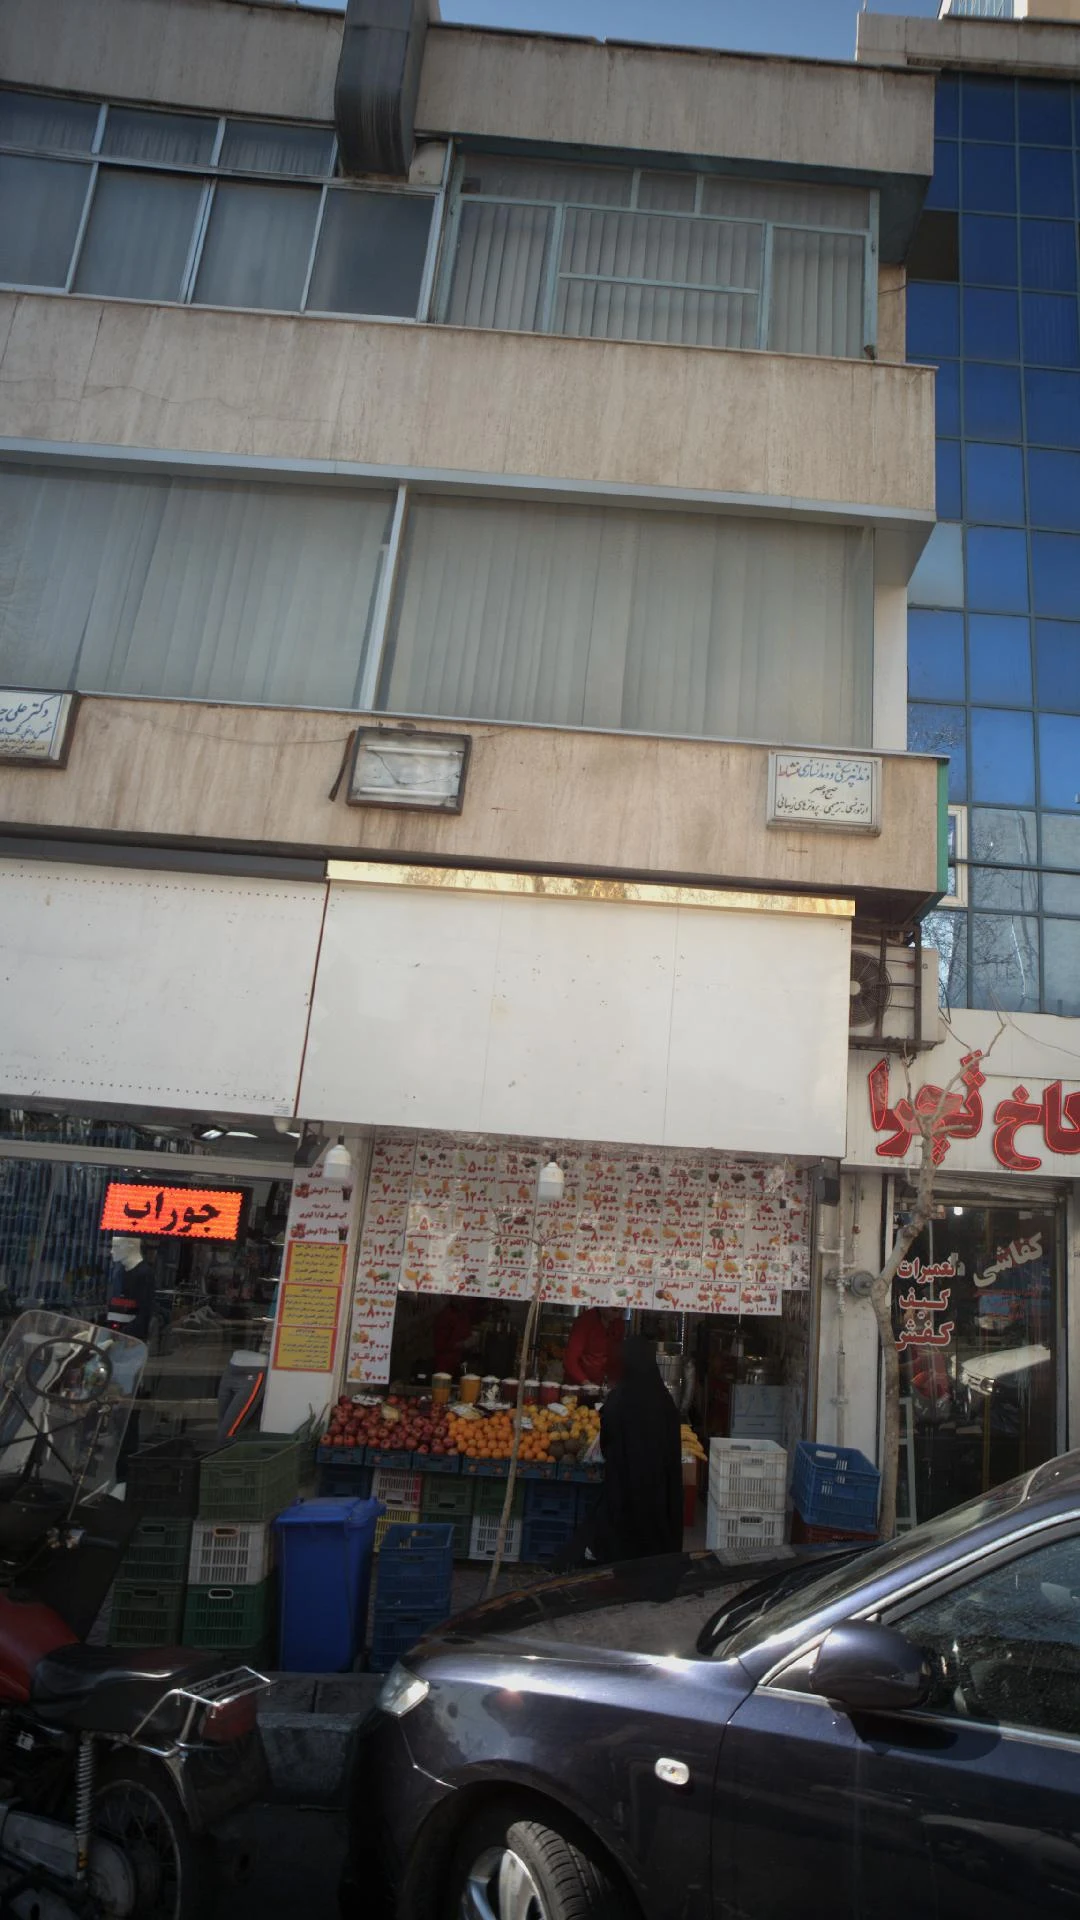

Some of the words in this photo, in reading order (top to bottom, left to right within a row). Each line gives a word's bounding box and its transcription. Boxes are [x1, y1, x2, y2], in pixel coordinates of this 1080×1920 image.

[123, 1191, 221, 1233] جوراب
[973, 1232, 1045, 1288] کفاشی
[898, 1287, 952, 1319] کیف
[894, 1320, 955, 1351] کفش
